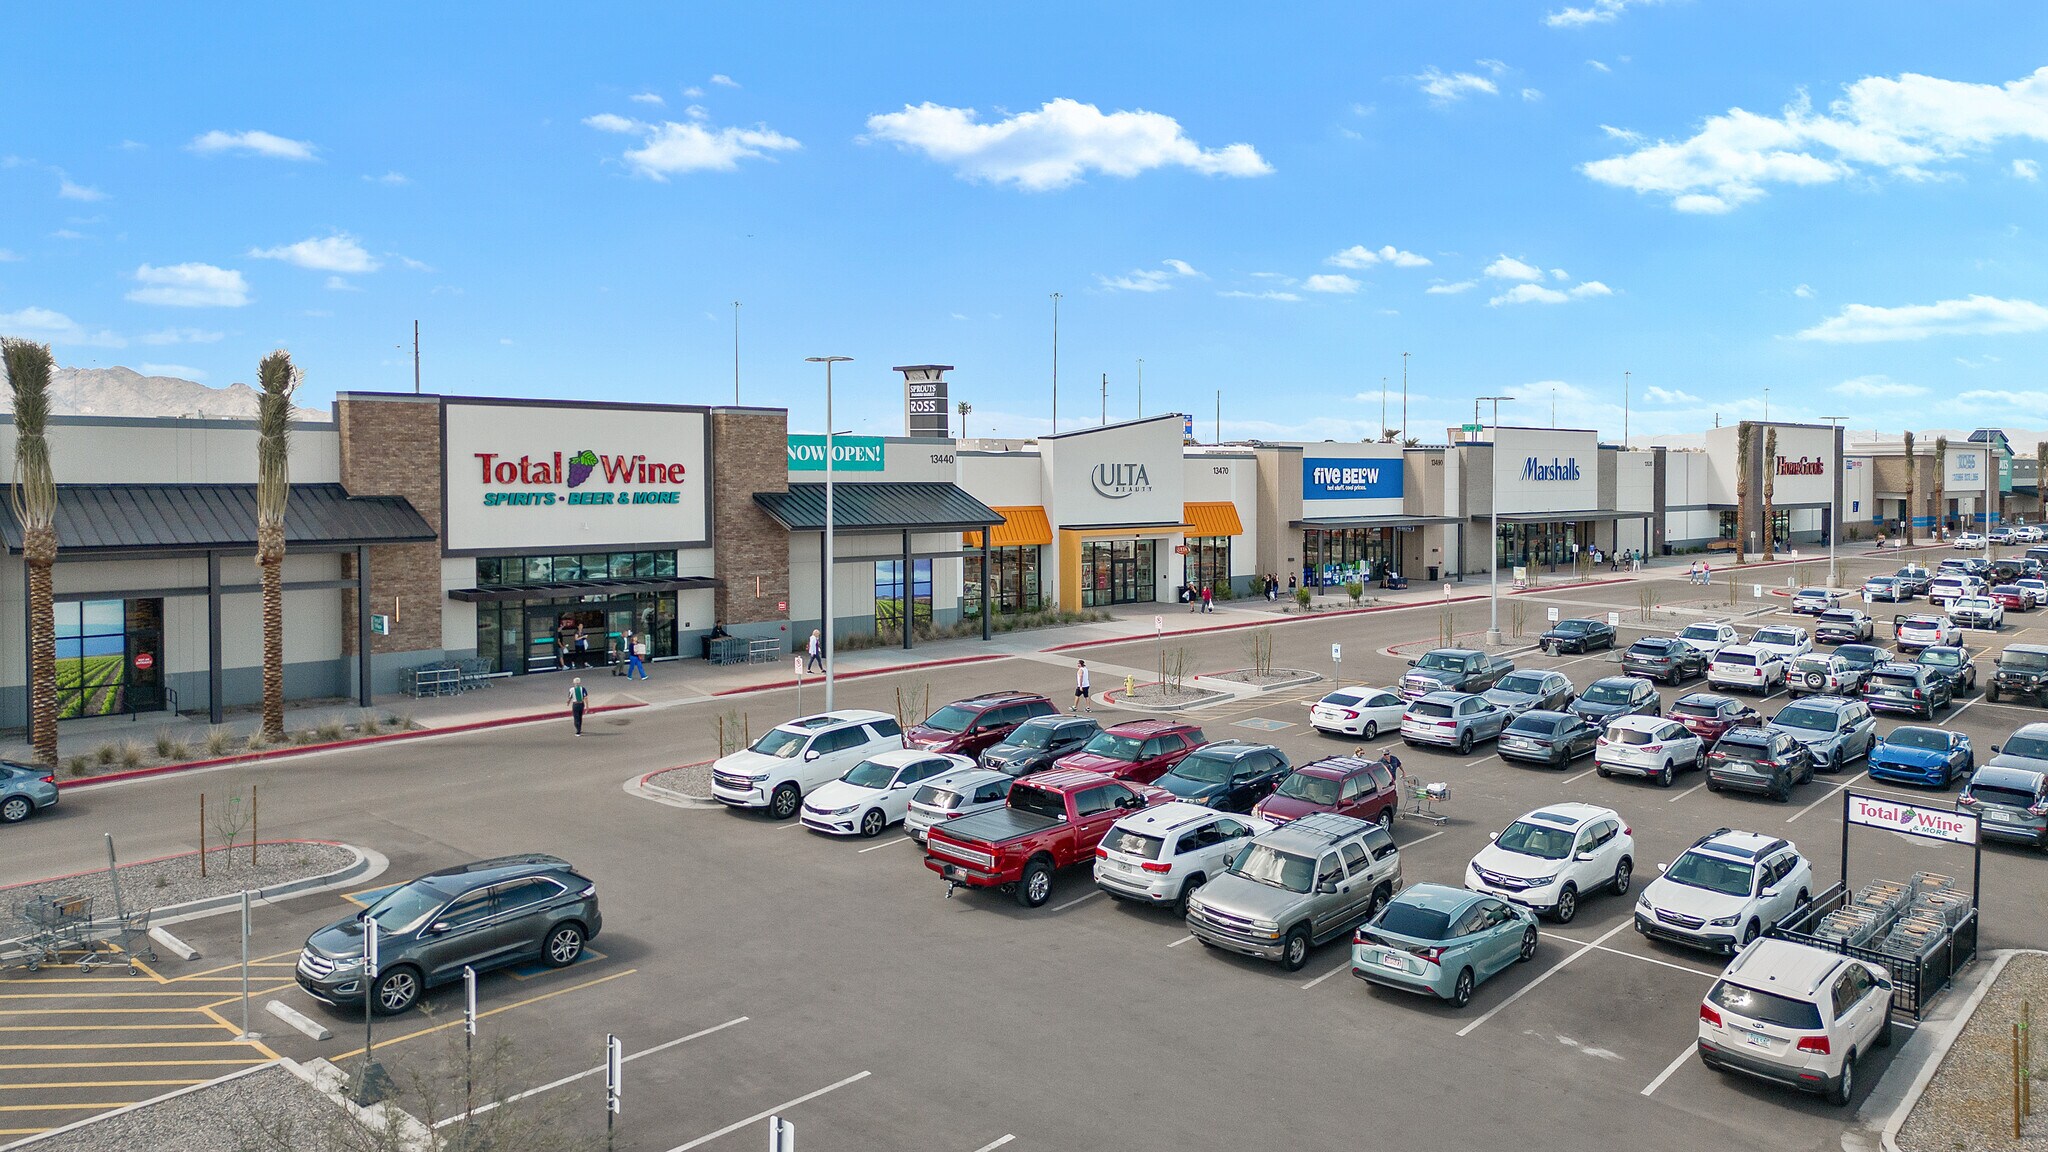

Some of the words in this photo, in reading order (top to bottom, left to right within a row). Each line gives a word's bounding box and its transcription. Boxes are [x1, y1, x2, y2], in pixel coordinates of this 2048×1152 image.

[910, 385, 936, 393] SPROUTS
[911, 401, 936, 412] ROSS
[787, 445, 827, 461] NOW
[832, 446, 880, 461] OPEN!
[930, 455, 954, 464] 13440
[474, 452, 562, 484] Total
[600, 455, 686, 484] Wine
[1100, 463, 1150, 486] ULTA
[1213, 467, 1229, 475] 13470
[1313, 467, 1341, 484] five
[1343, 468, 1379, 484] BELOW
[1519, 457, 1580, 481] Marshalls
[484, 492, 556, 506] SPIRITS
[568, 492, 614, 505] BEER
[617, 492, 629, 504] &
[632, 492, 680, 504] MORE
[1858, 803, 1898, 821] Total
[1918, 813, 1963, 833] Wine
[1922, 827, 1948, 836] MORE
